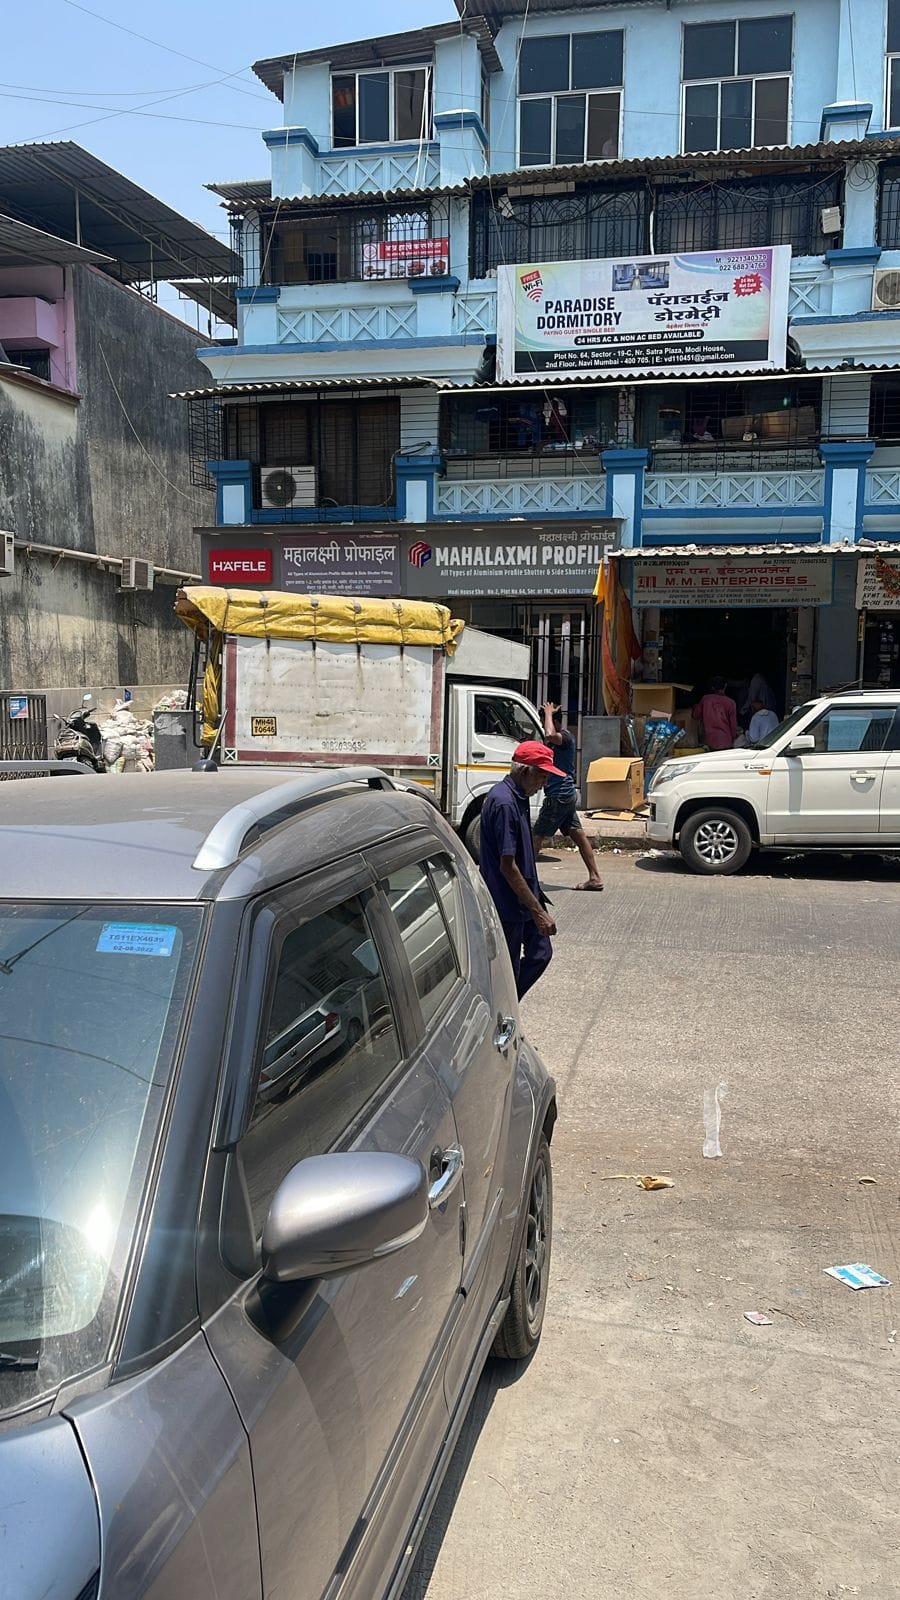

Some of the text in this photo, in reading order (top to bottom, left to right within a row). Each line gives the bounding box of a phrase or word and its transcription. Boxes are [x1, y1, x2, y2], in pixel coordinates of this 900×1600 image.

[522, 274, 538, 283] FREE
[522, 280, 543, 292] Wi-Fi
[545, 297, 615, 314] PARADISE
[647, 289, 730, 306] पॅराडाईज
[537, 312, 622, 330] DORMITORY
[654, 306, 722, 321] डोरमेट्री
[284, 540, 396, 567] महालक्ष्मी प्रोफाइल
[435, 546, 537, 566] MAHALAXMI
[701, 576, 807, 586] ENTERPRISES
